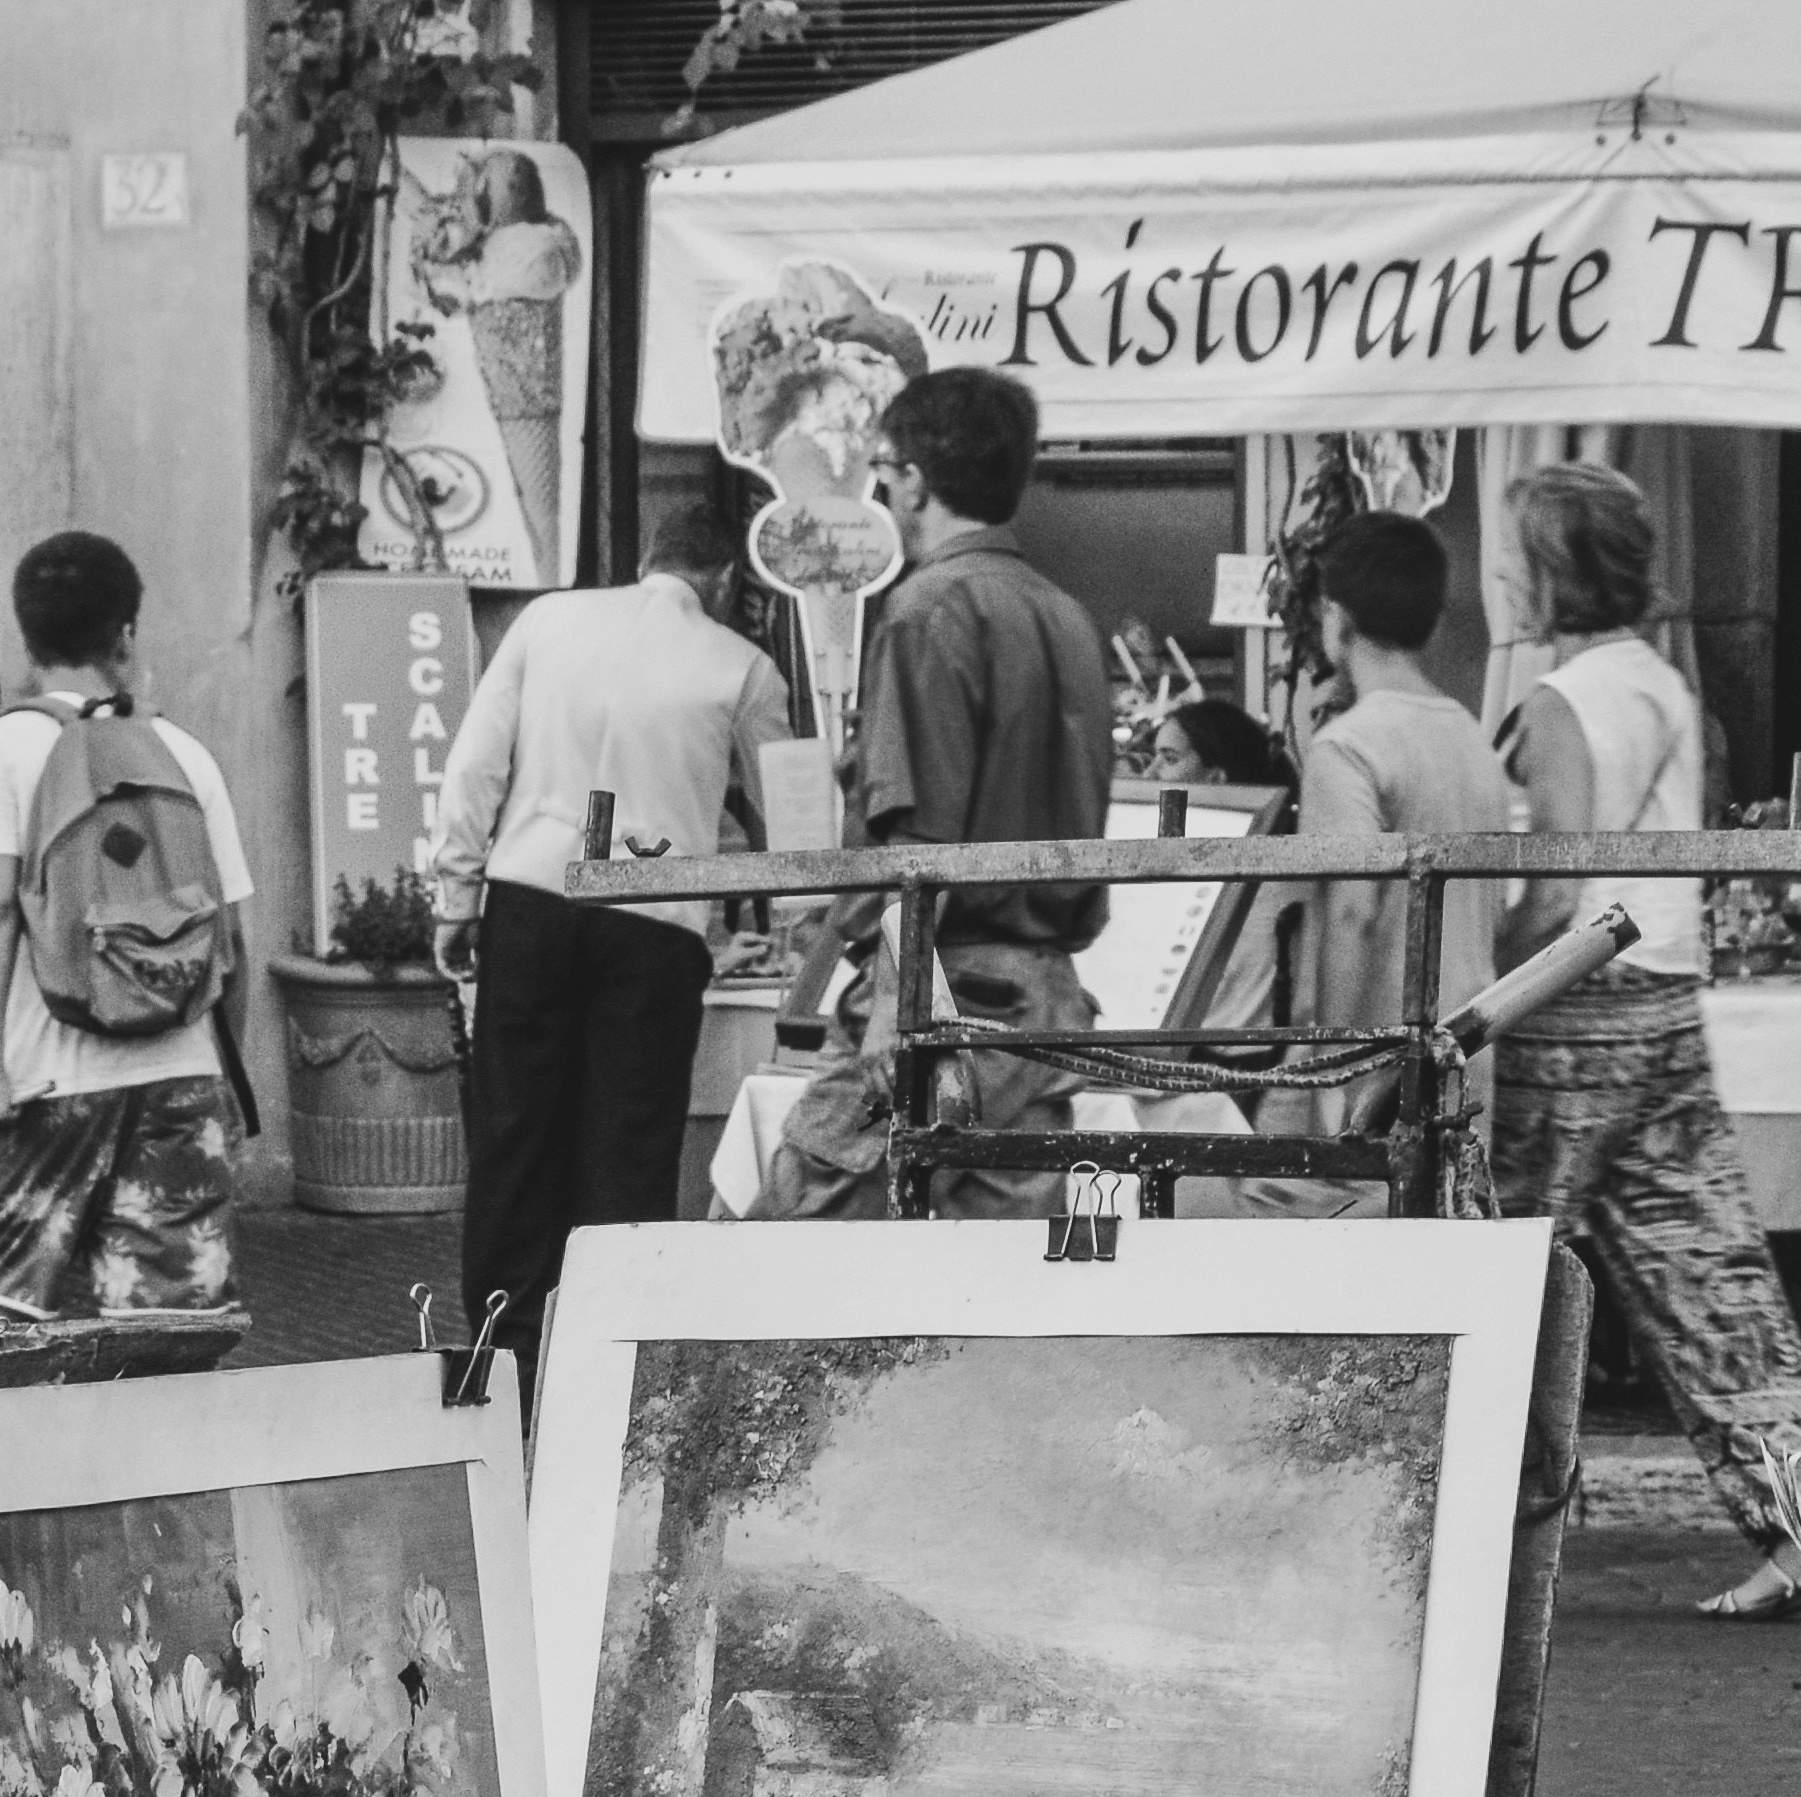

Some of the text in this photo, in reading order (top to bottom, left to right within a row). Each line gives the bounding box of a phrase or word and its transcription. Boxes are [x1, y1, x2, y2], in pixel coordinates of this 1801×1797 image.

[996, 217, 1613, 368] Ristorante
[449, 548, 510, 562] MADE
[342, 702, 381, 831] TRE
[407, 611, 447, 876] SCALIN
